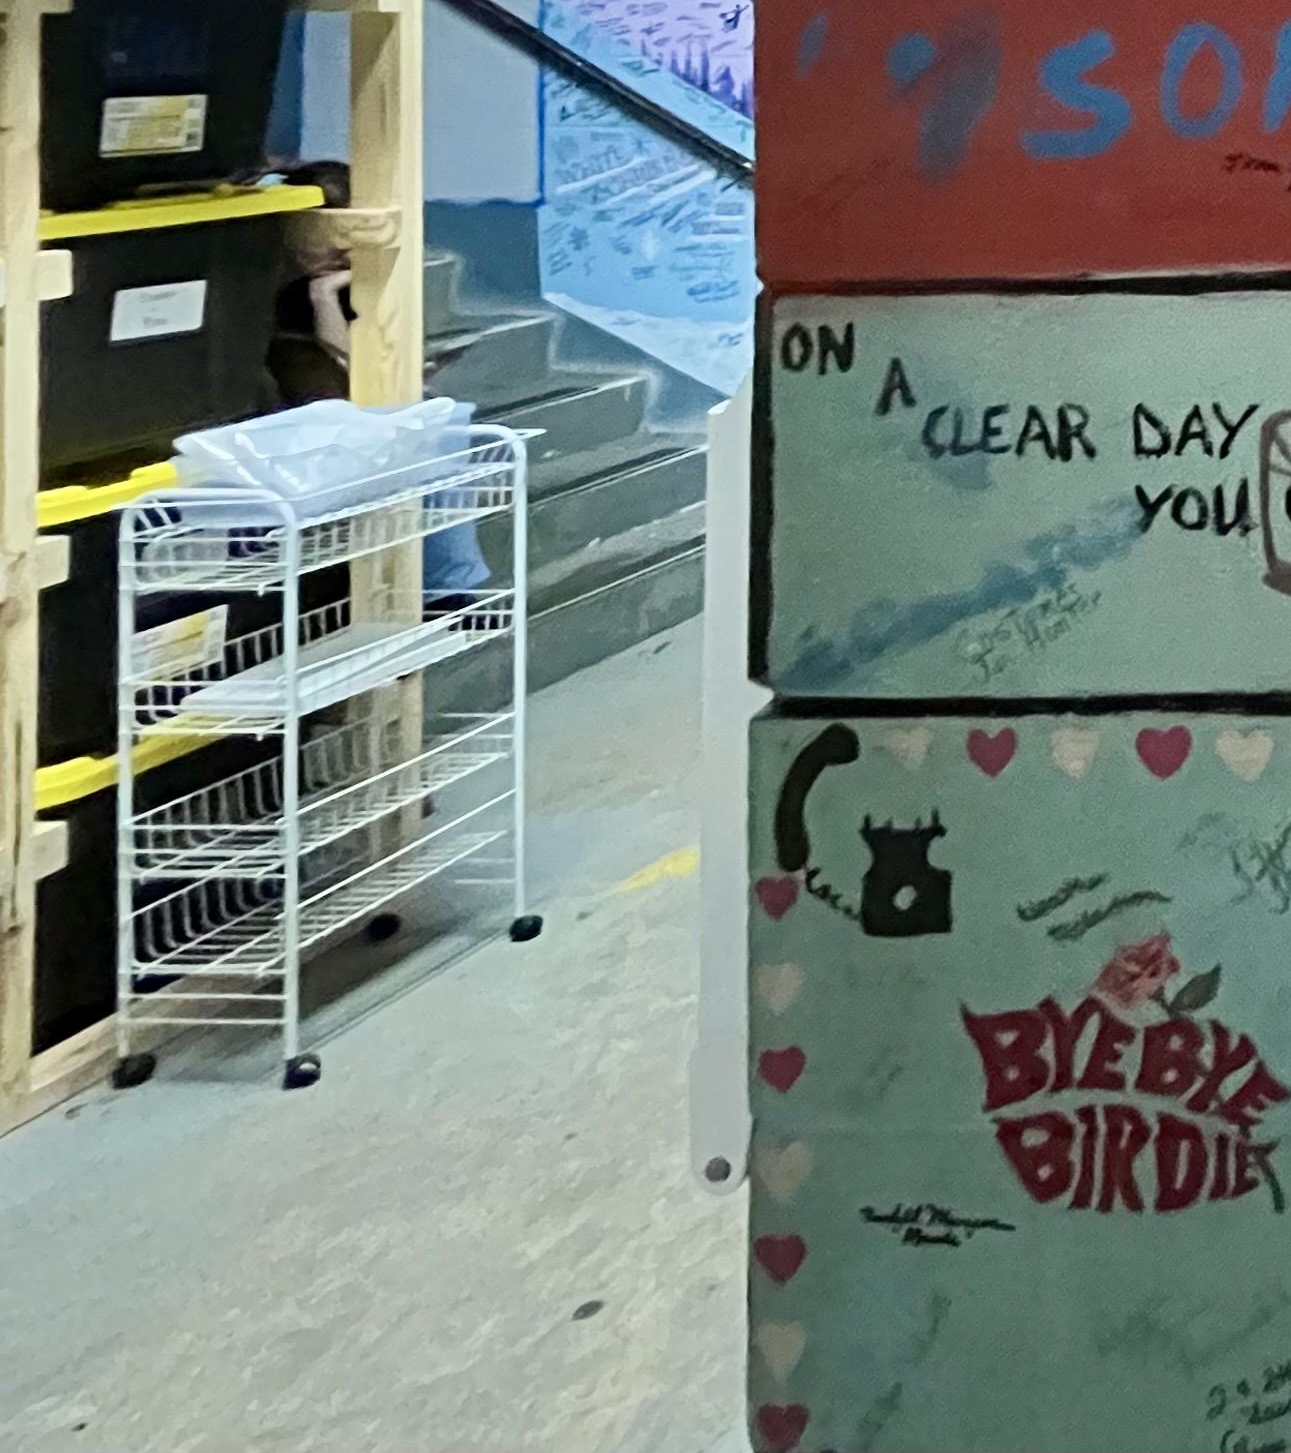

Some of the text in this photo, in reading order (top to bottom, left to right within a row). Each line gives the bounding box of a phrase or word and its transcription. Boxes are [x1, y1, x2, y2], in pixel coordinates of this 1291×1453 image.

[780, 322, 1261, 462] ON A CLEAR DAY
[1133, 478, 1252, 538] YOU
[992, 1103, 1286, 1215] BIRDIE
